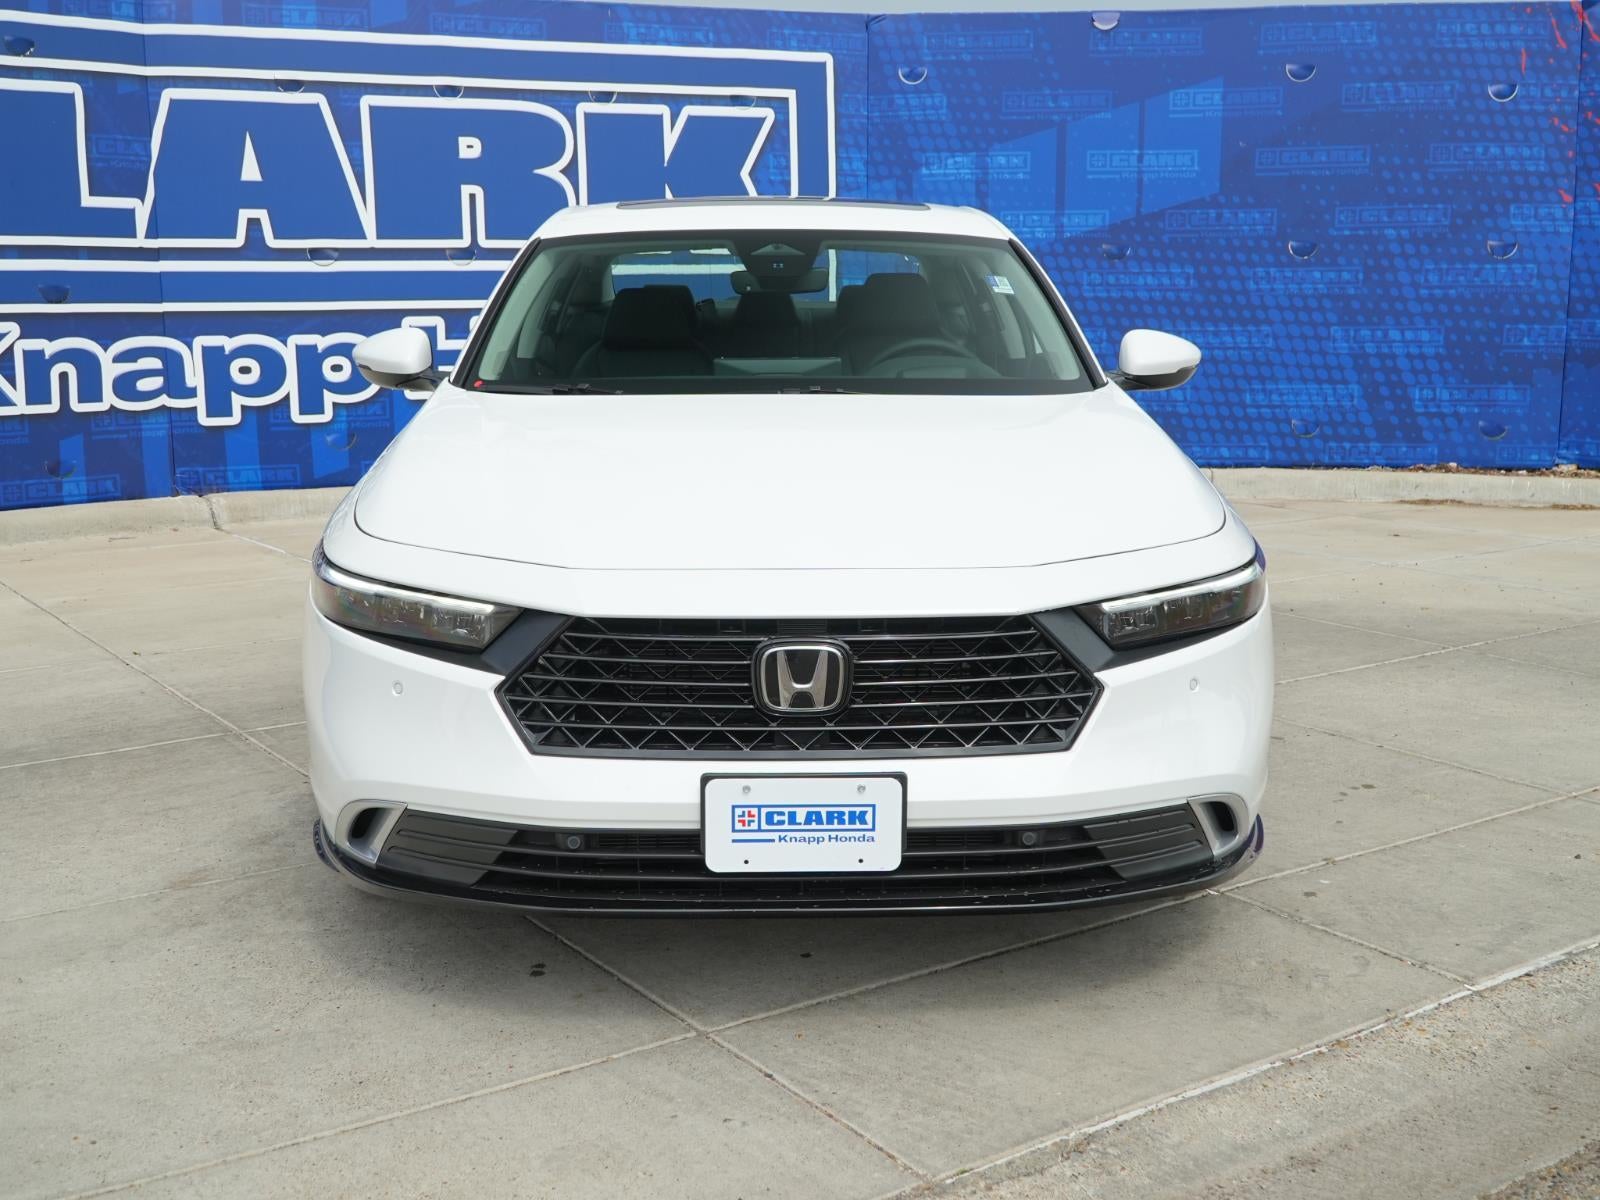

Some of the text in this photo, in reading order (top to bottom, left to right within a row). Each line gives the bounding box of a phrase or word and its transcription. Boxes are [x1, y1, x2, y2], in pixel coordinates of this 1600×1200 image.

[1111, 152, 1193, 168] CLARK
[764, 810, 869, 826] CLARK
[778, 834, 876, 845] Knapp Honda
